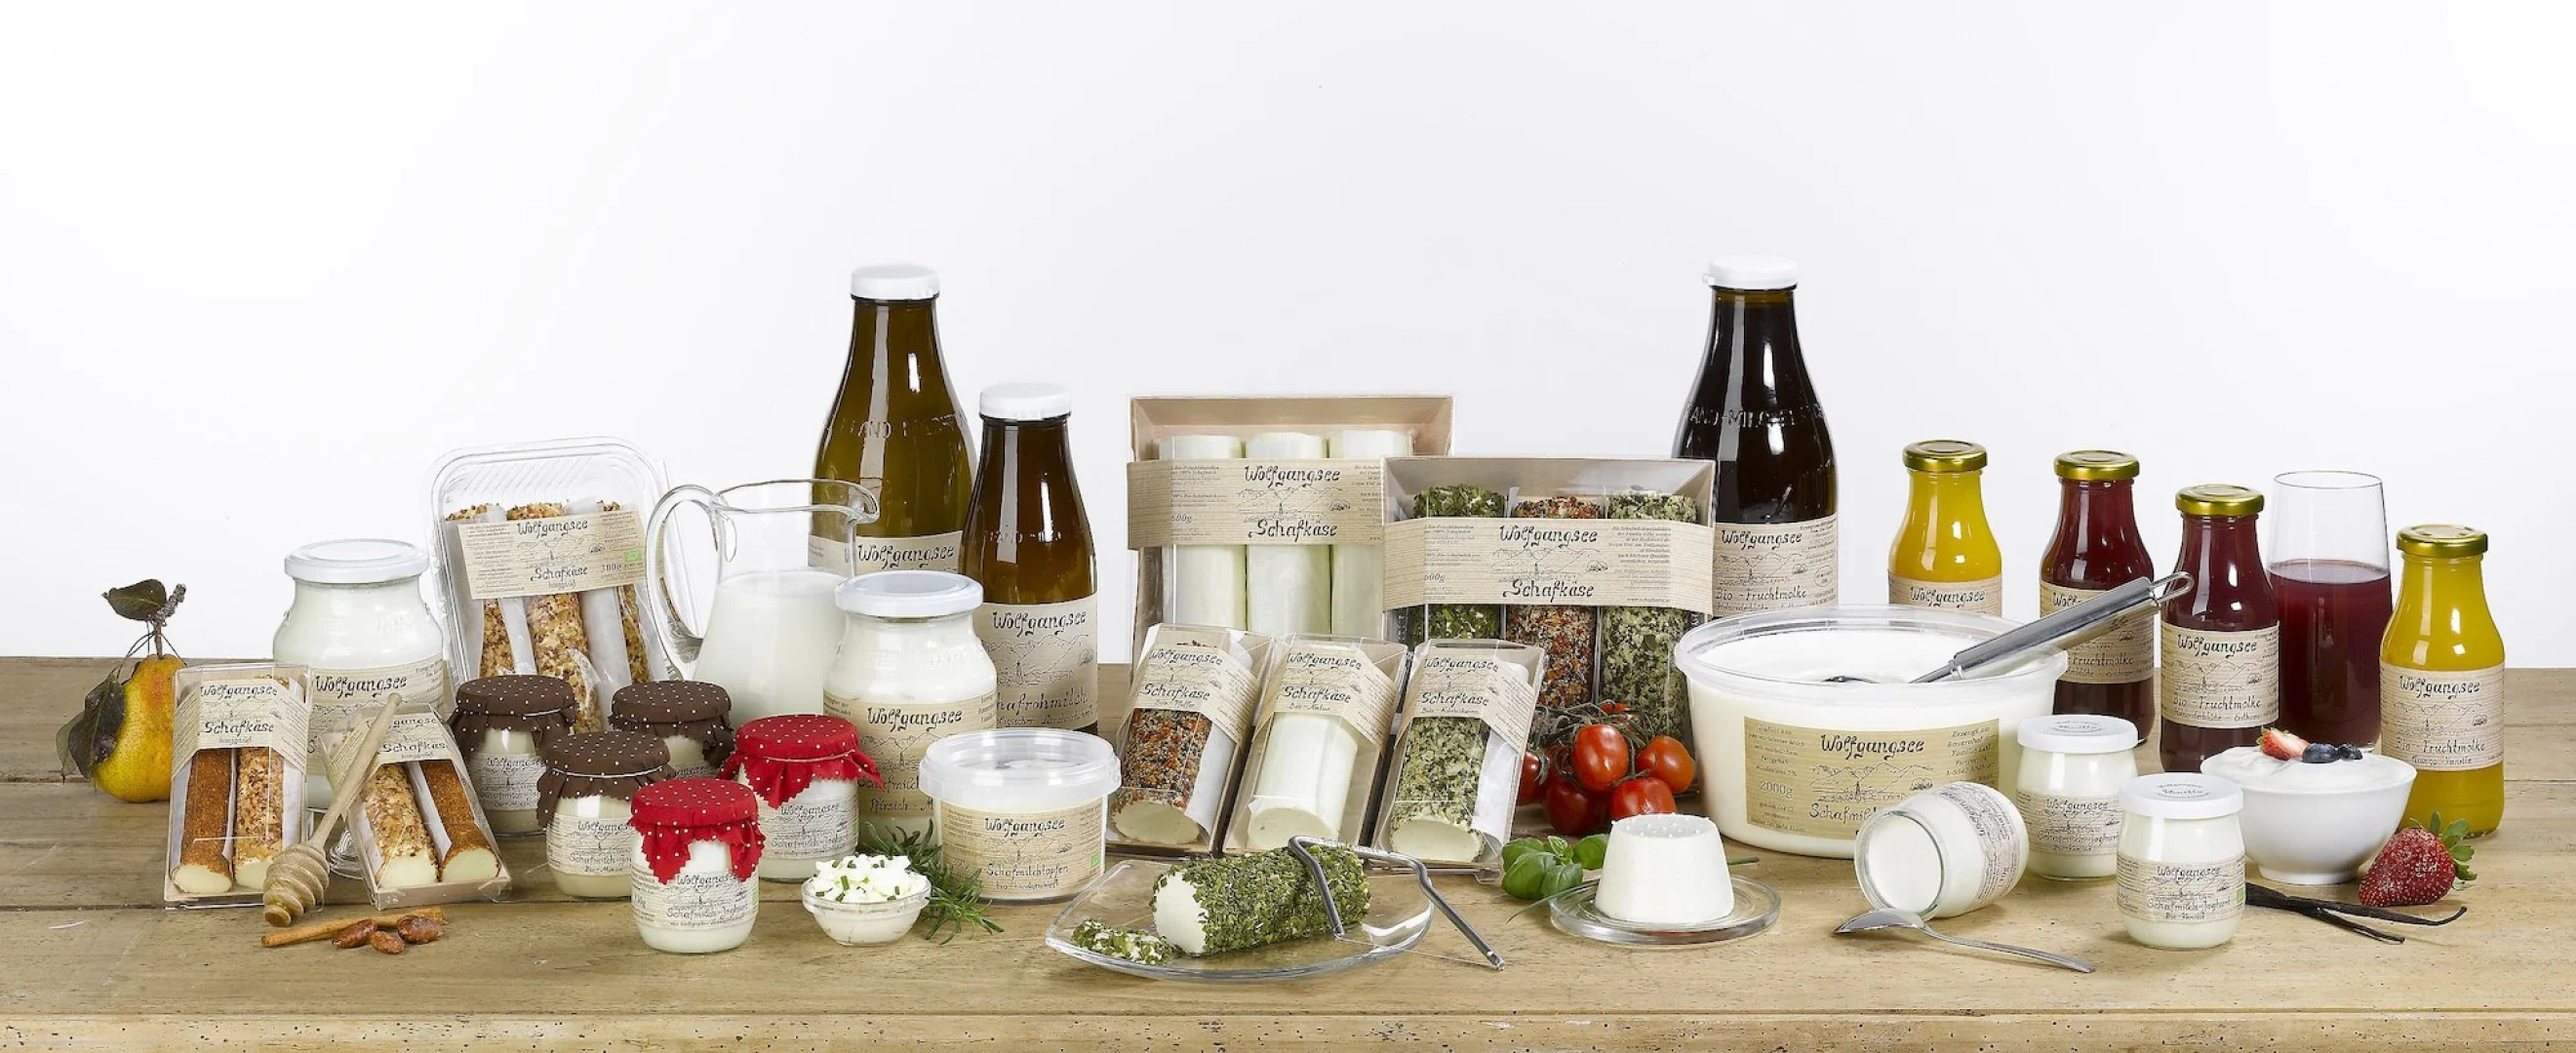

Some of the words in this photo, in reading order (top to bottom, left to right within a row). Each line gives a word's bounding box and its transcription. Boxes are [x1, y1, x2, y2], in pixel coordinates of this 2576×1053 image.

[1245, 465, 1341, 488] Wolfgangsee
[517, 520, 588, 538] Wolfgangsee
[1248, 518, 1338, 542] Schafkäse
[1499, 525, 1598, 549] Wolfgangsee
[1721, 529, 1803, 551] Wolfgangsee
[857, 544, 954, 569] Wolfgangsee
[530, 566, 588, 582] Schafkäse
[1502, 579, 1595, 604] Schafkäse
[1910, 586, 1986, 608] Wolfgangsee
[992, 610, 1087, 638] Wolfgangsee
[1149, 648, 1223, 666] Wolfgangsee
[2177, 634, 2258, 659] Wolfgangsee
[1287, 651, 1363, 670] Wolfgangsee
[1424, 657, 1499, 673] Wolfgangsee
[200, 683, 278, 700] Wolfgangsee
[315, 675, 408, 700] Wolfgangsee
[1139, 682, 1210, 701] Schafkäse
[1276, 685, 1352, 703] Schafkäse
[2399, 675, 2481, 700] Wolfgangsee
[1420, 691, 1490, 708] Schafkäse
[2199, 694, 2261, 710] Fruchtmolke
[199, 720, 274, 737] Schafkäse
[867, 707, 963, 732] Wolfgangsee
[1821, 734, 1925, 760] Wolfgangsee
[2423, 739, 2485, 754] Fruchtmolke
[1760, 779, 1794, 800] 2000g
[984, 817, 1065, 838] Wolfgangsee
[986, 862, 1069, 879] Schafmilchtopfen
